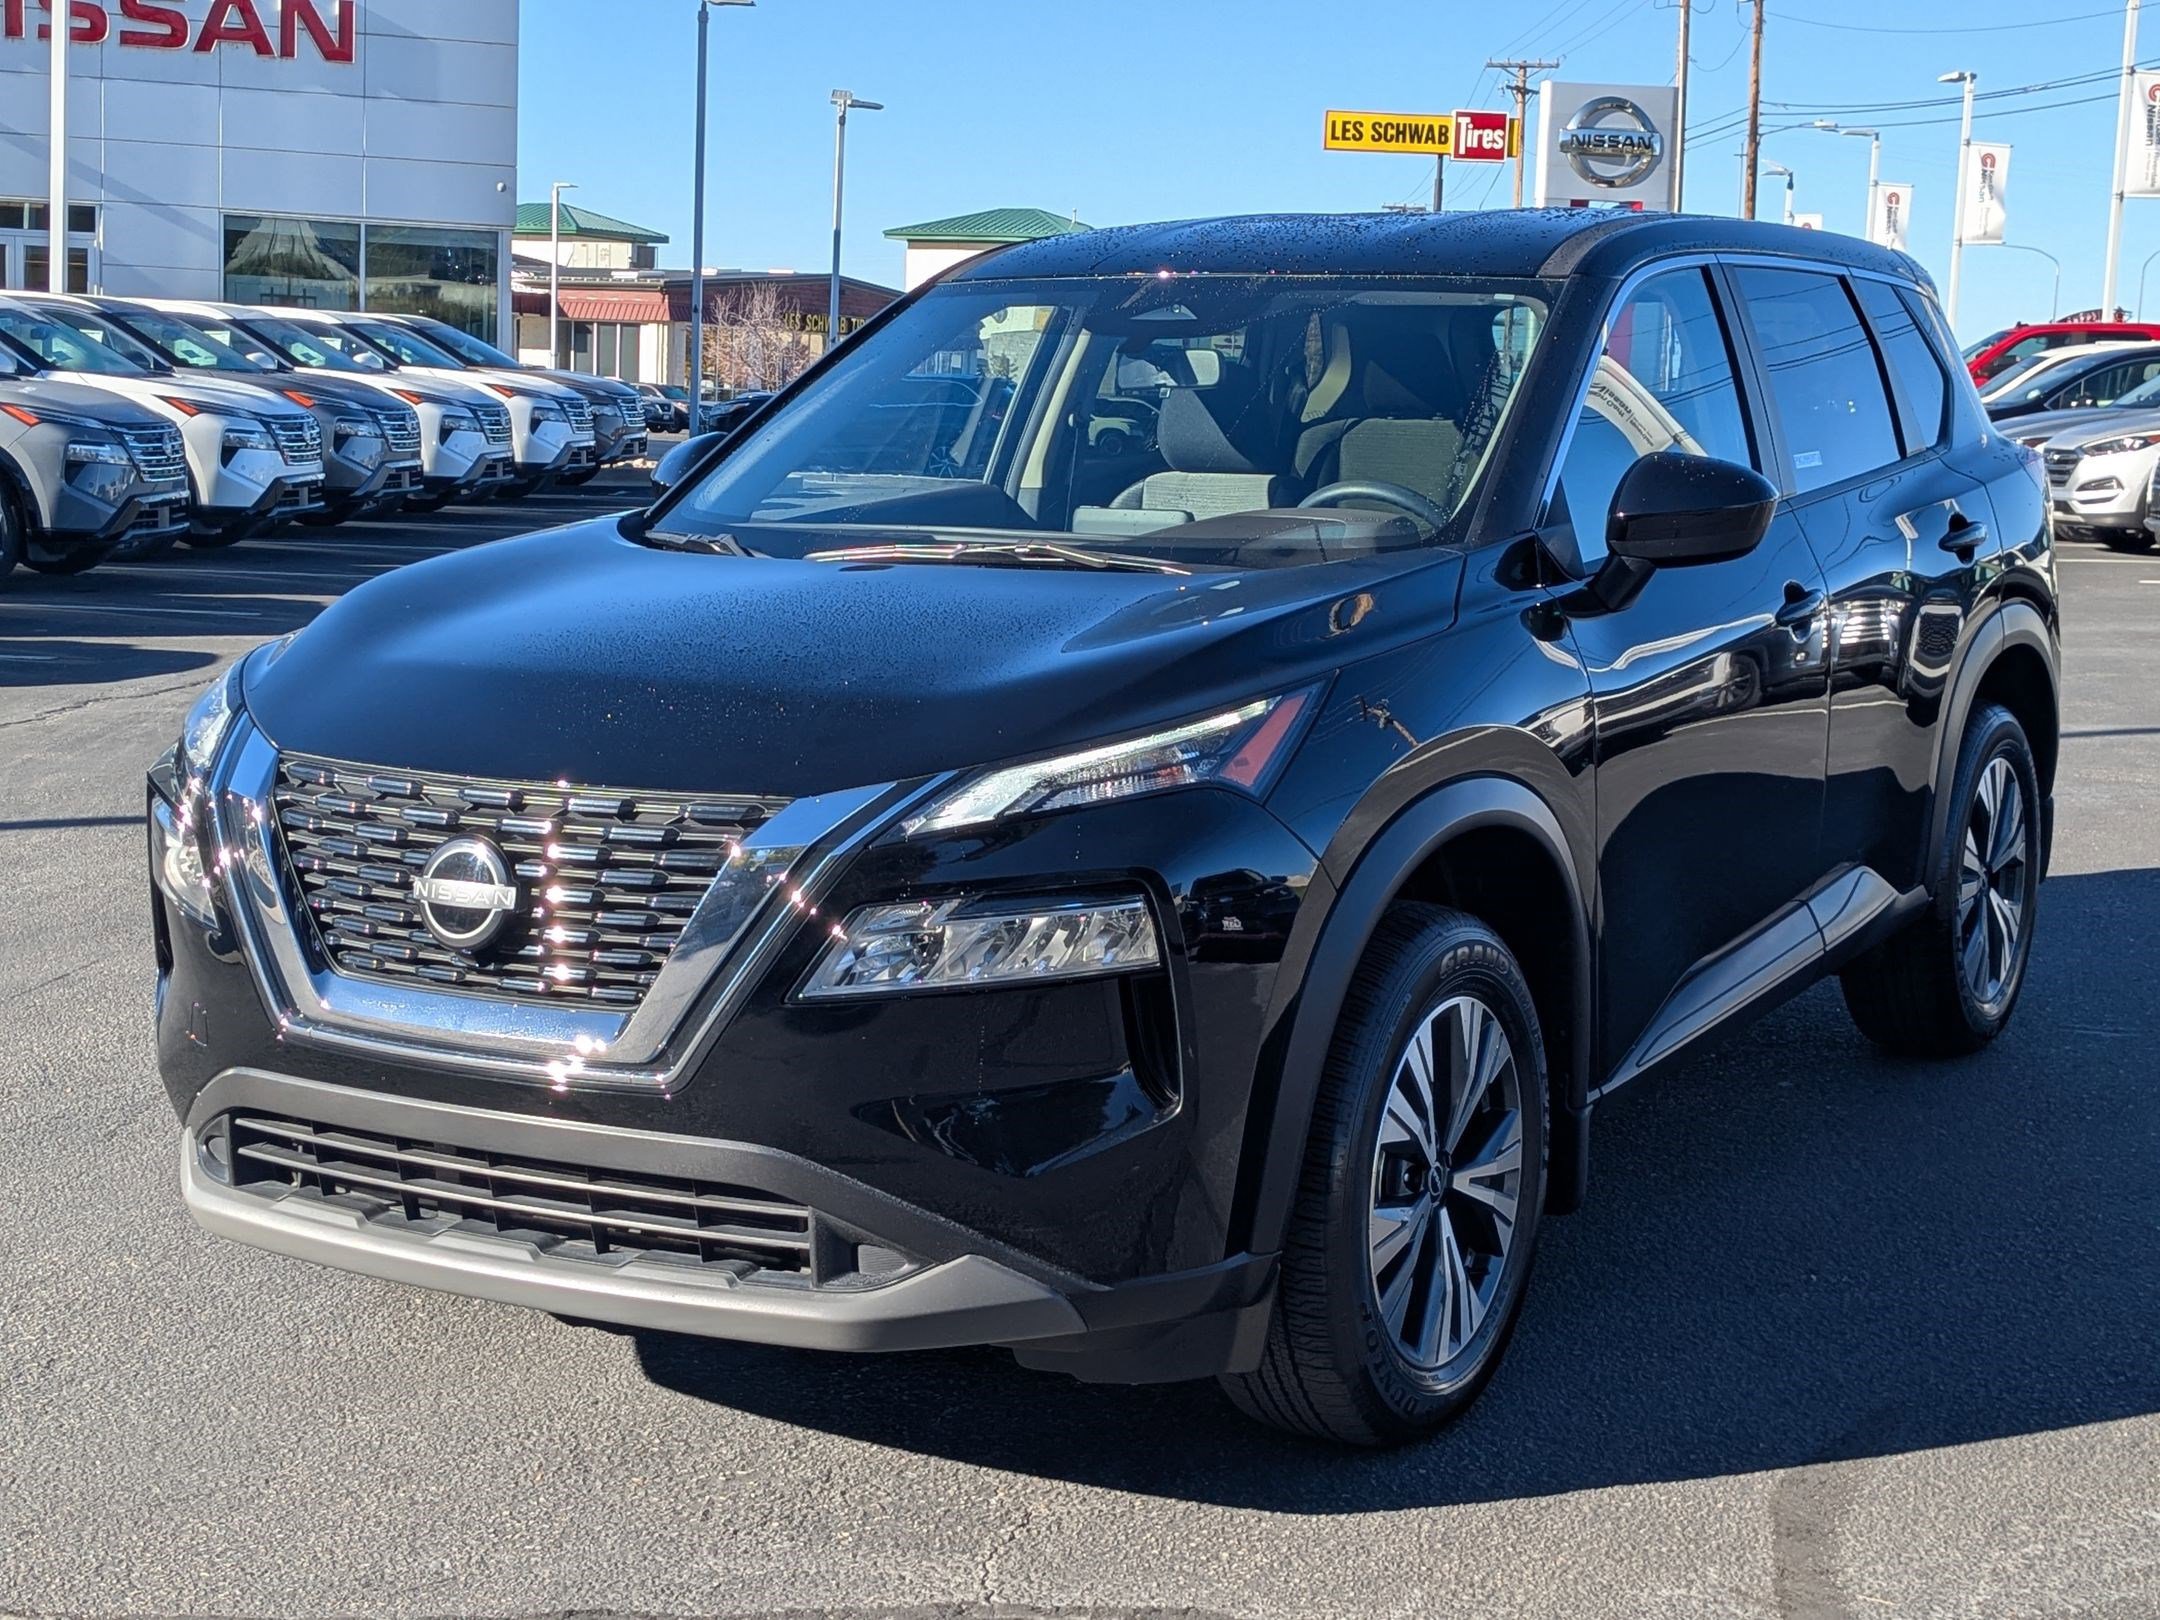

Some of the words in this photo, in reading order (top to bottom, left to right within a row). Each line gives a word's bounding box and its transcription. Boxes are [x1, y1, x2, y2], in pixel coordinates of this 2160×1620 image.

[4, 0, 356, 63] ISSAN
[1330, 120, 1364, 142] LES
[1370, 121, 1450, 146] SCHWAB
[1457, 116, 1505, 155] Tires
[1570, 133, 1654, 150] NISSAN
[784, 313, 801, 330] LES
[805, 313, 847, 333] SCHWB
[415, 880, 513, 907] NISSAN
